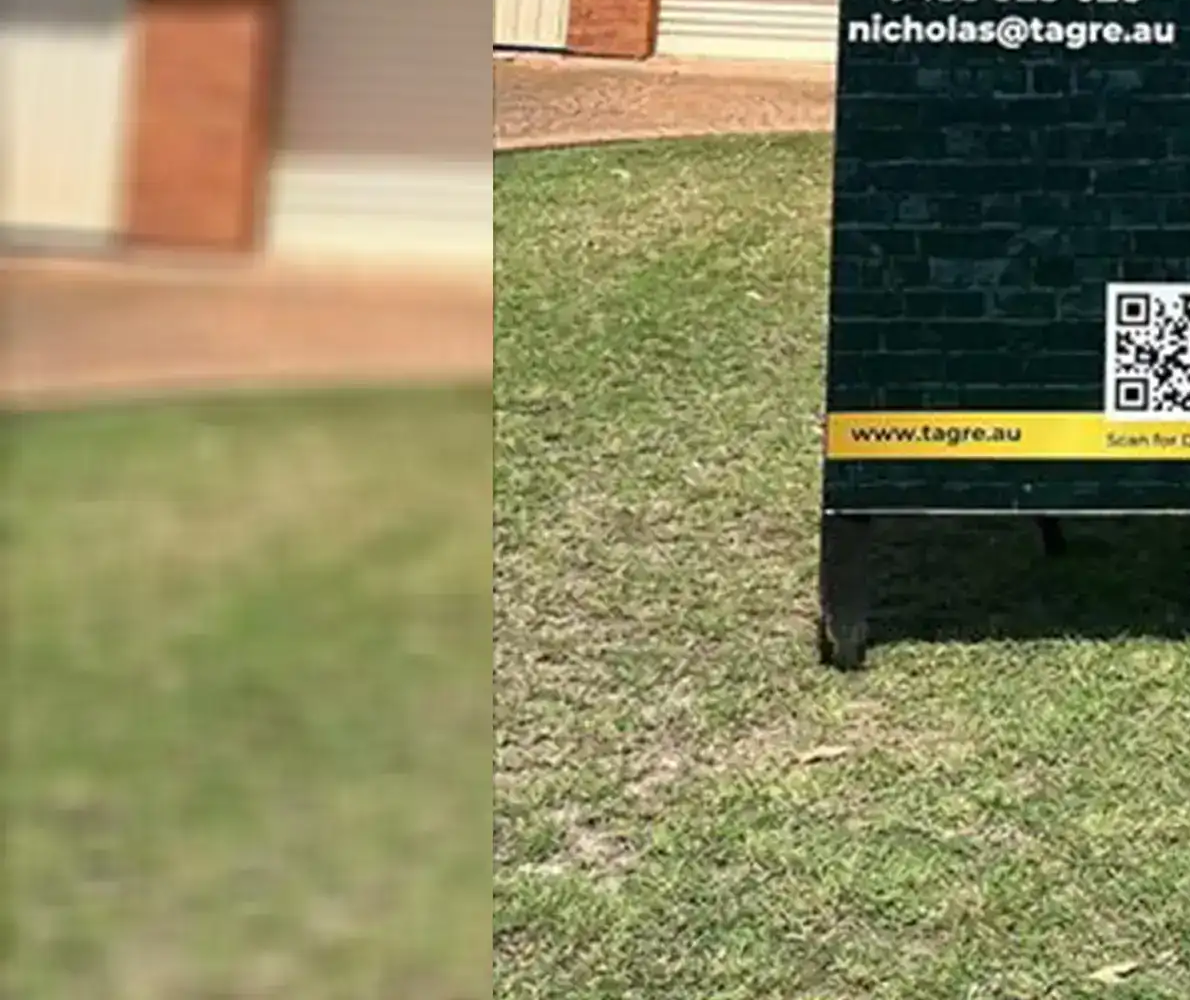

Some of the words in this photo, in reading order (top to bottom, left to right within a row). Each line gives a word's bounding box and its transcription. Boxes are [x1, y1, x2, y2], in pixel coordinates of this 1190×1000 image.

[847, 14, 1176, 49] nicholas@tagre.au
[850, 425, 1022, 446] www.tagre.au
[1106, 432, 1150, 448] Scan
[1153, 431, 1178, 448] for
